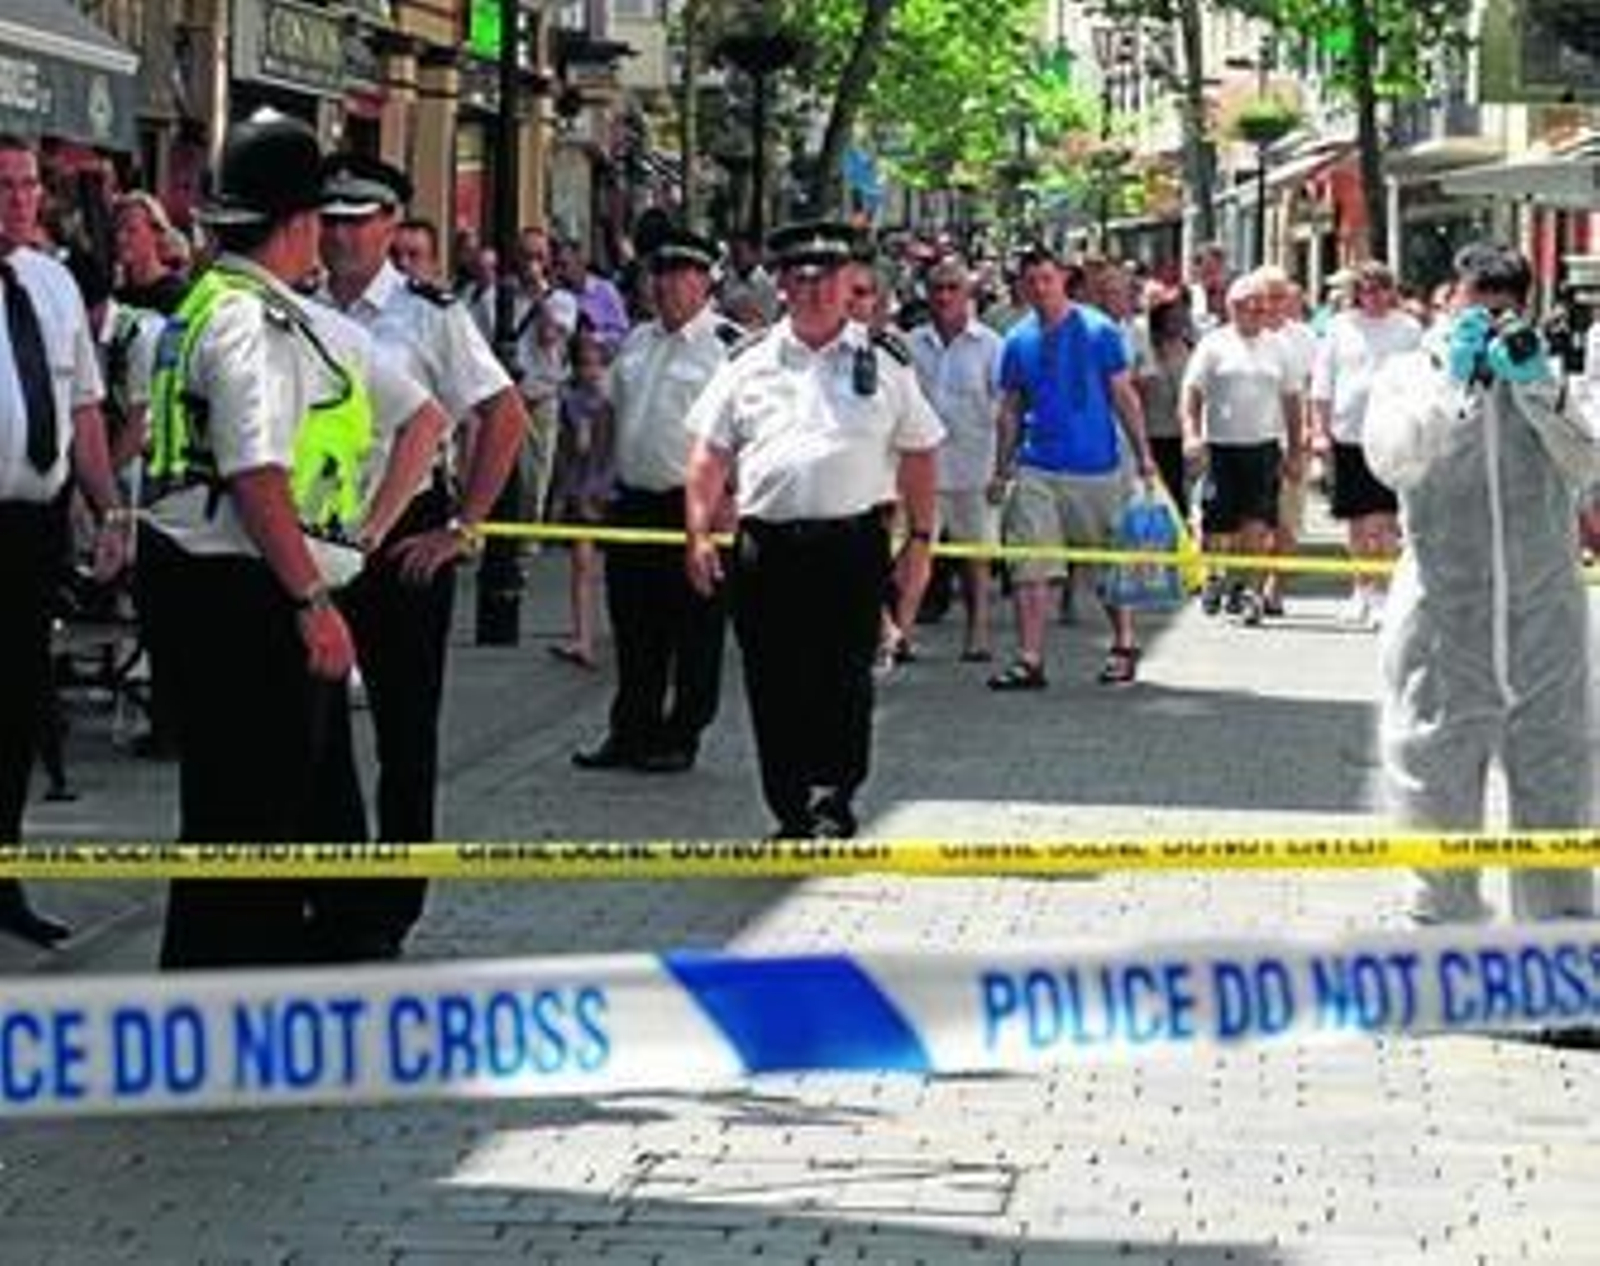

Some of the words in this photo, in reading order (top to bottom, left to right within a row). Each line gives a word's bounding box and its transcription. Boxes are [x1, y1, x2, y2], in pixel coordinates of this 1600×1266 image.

[1, 1012, 85, 1101] CE
[113, 1004, 205, 1094] DO
[235, 997, 366, 1090] NOT
[389, 985, 611, 1084] CROSS
[981, 962, 1196, 1050] POLICE
[1213, 957, 1297, 1040] DO
[1312, 951, 1420, 1032] NOT
